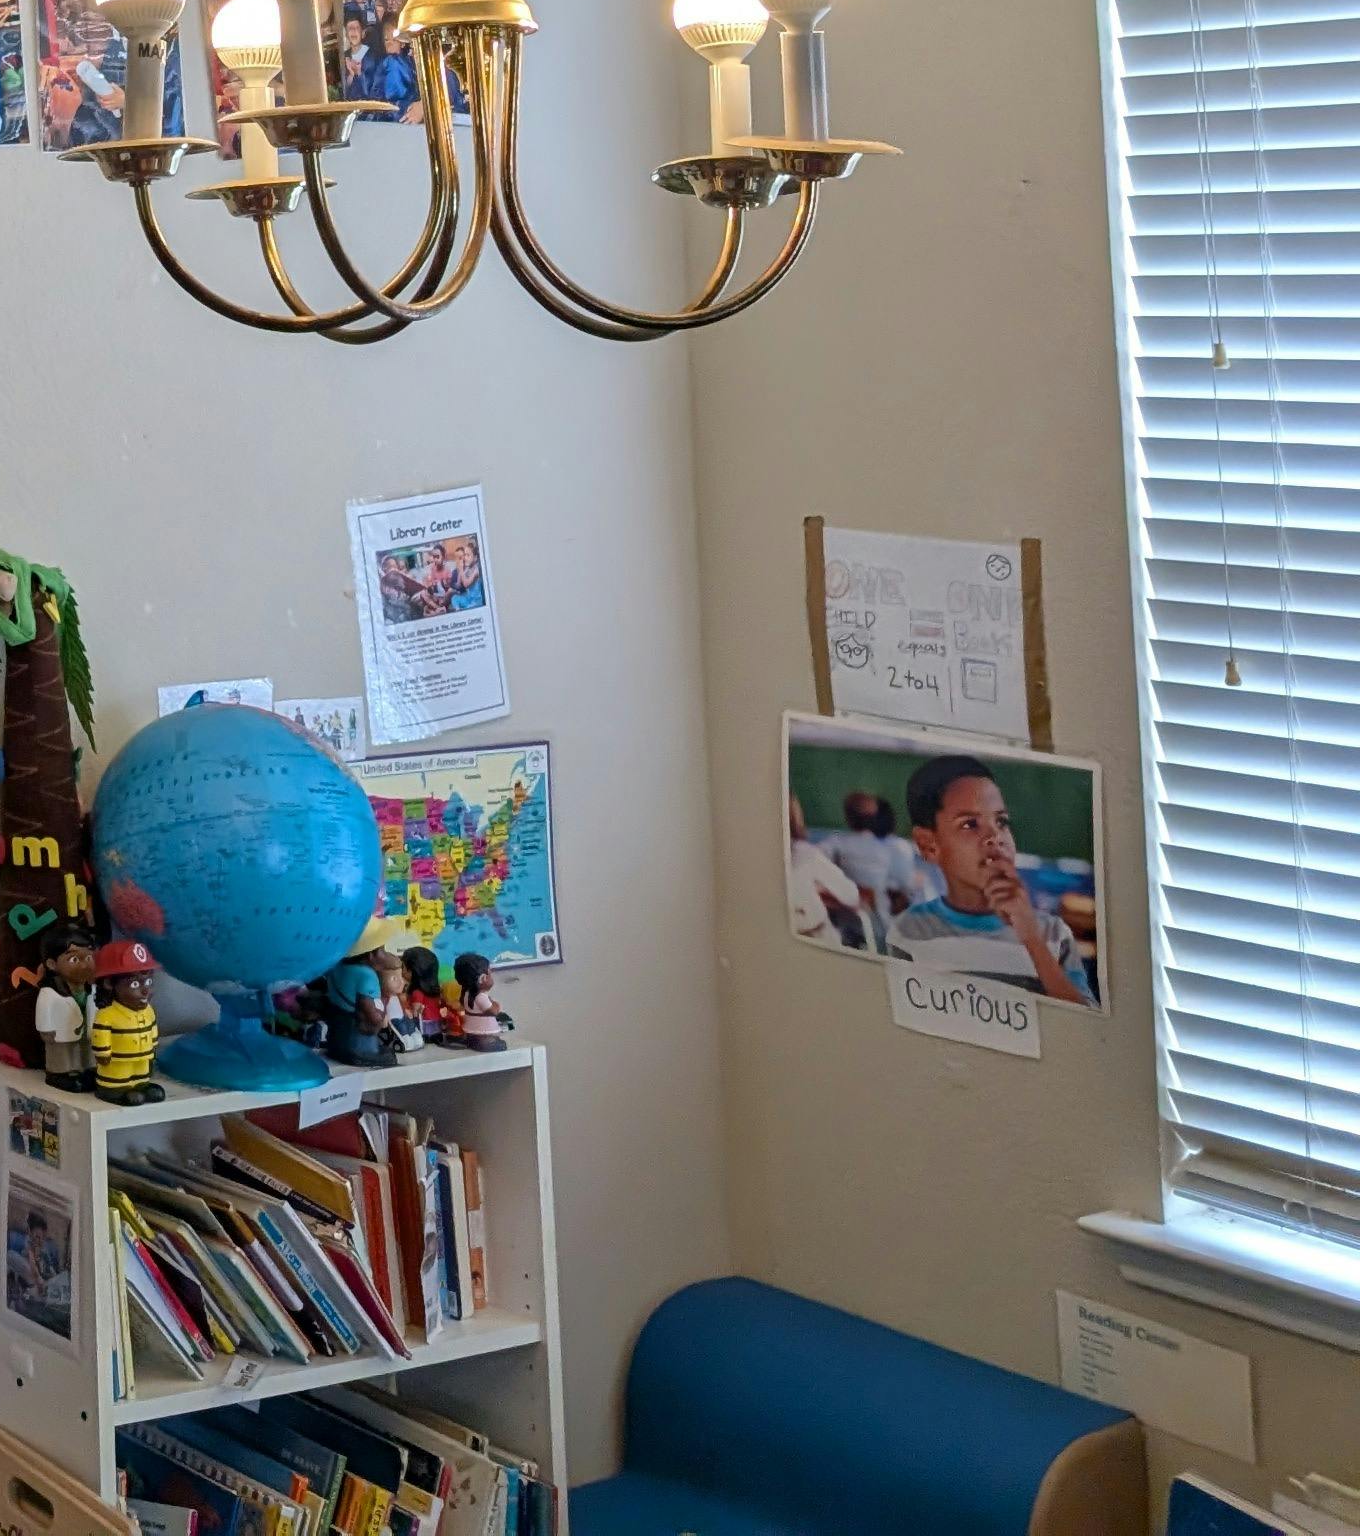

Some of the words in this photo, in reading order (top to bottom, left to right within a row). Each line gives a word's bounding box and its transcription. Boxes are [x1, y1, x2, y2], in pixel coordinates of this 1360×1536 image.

[390, 525, 426, 541] Library
[430, 517, 463, 534] Center
[12, 836, 60, 868] m
[64, 873, 87, 917] h
[905, 976, 1029, 1032] Curious
